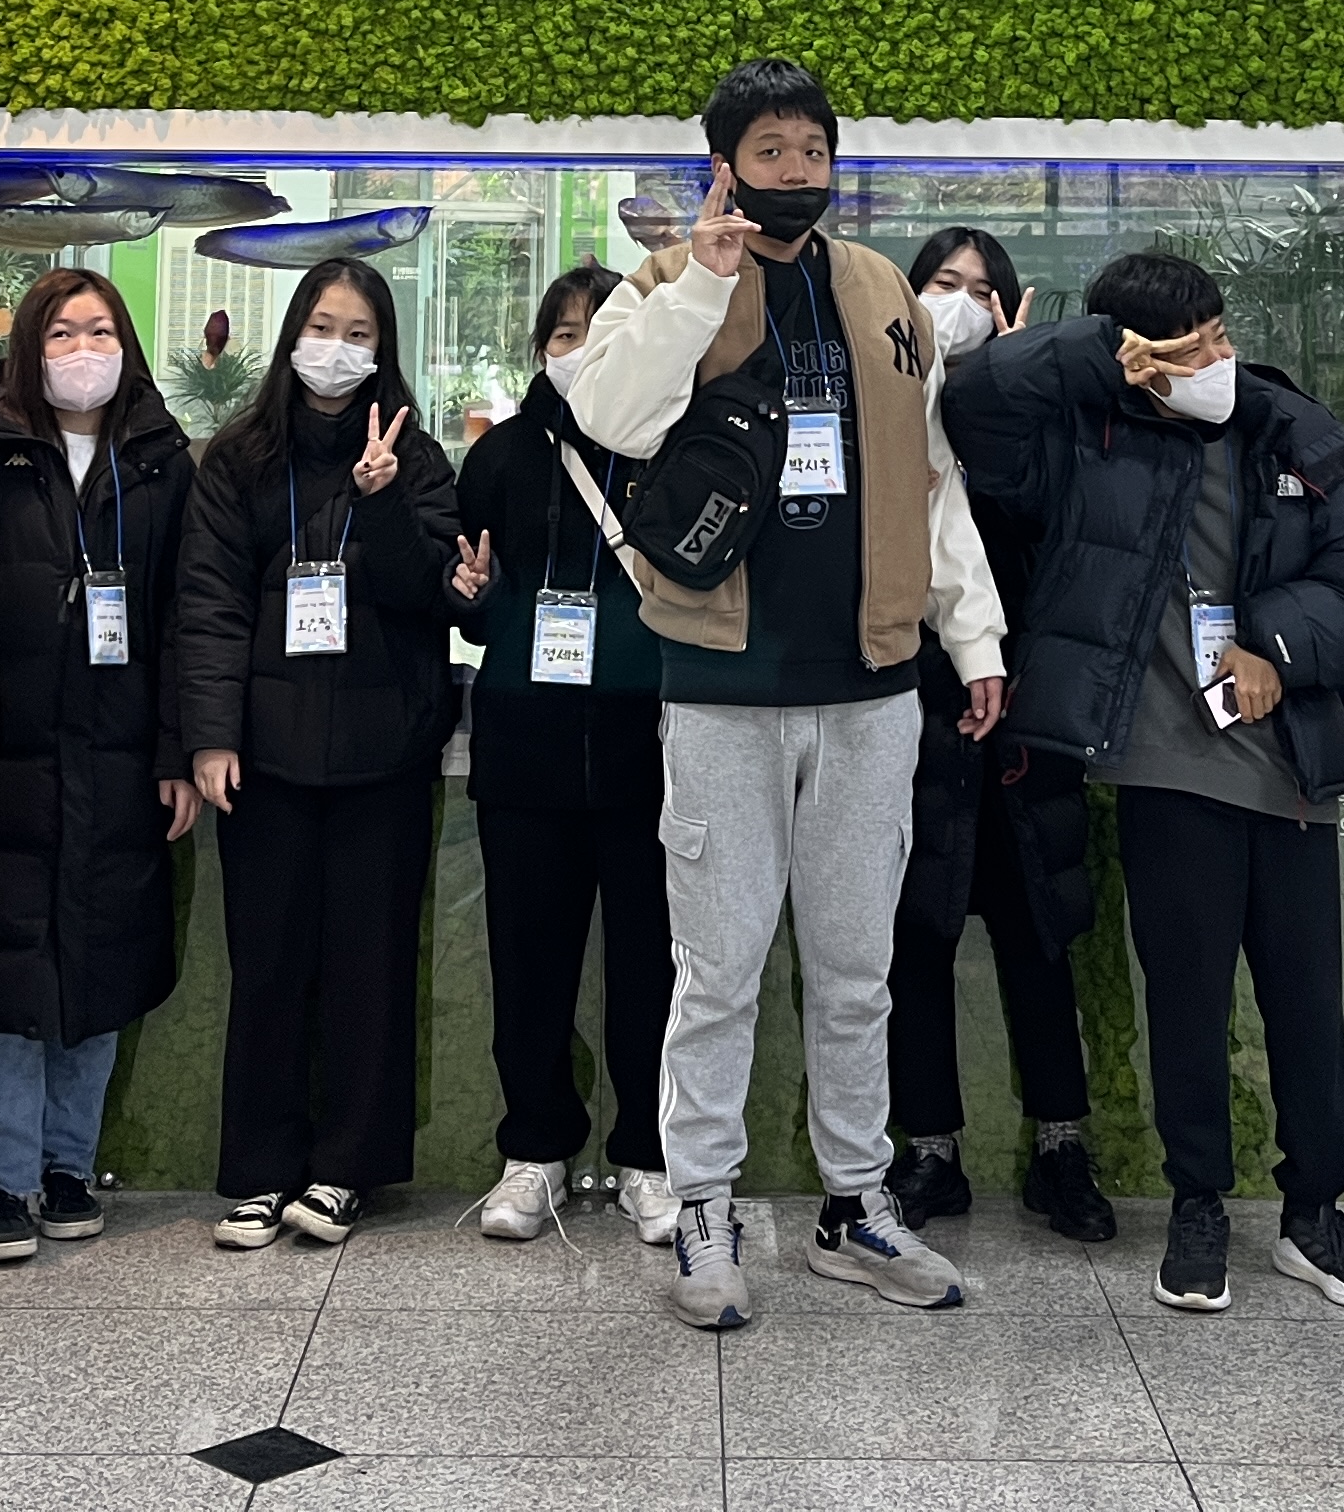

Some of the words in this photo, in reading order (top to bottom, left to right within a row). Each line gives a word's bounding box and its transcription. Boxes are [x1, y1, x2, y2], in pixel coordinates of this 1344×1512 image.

[885, 318, 923, 380] NY
[788, 457, 831, 475] 박시후
[683, 499, 730, 553] FILA
